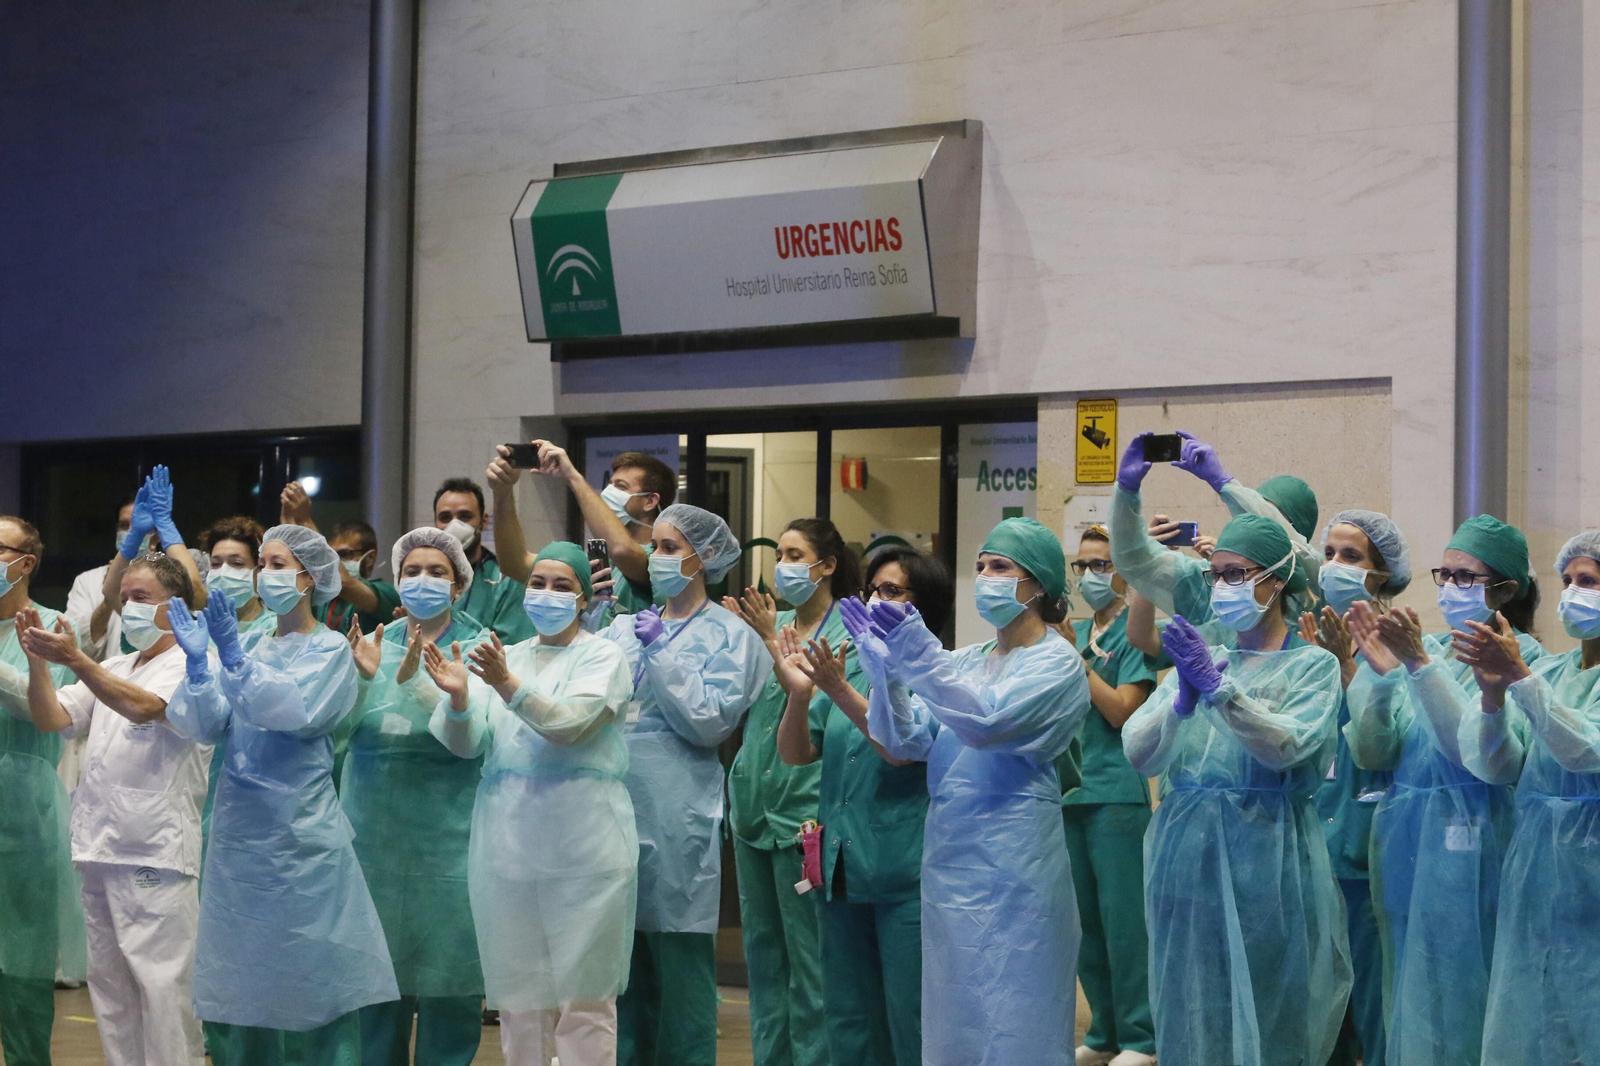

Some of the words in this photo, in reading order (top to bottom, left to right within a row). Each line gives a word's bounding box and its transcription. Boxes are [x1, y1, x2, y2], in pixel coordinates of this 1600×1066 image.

[775, 217, 903, 260] URGENCIAS
[725, 274, 771, 299] Hospital
[772, 269, 842, 294] Universitario
[843, 267, 877, 288] Reina
